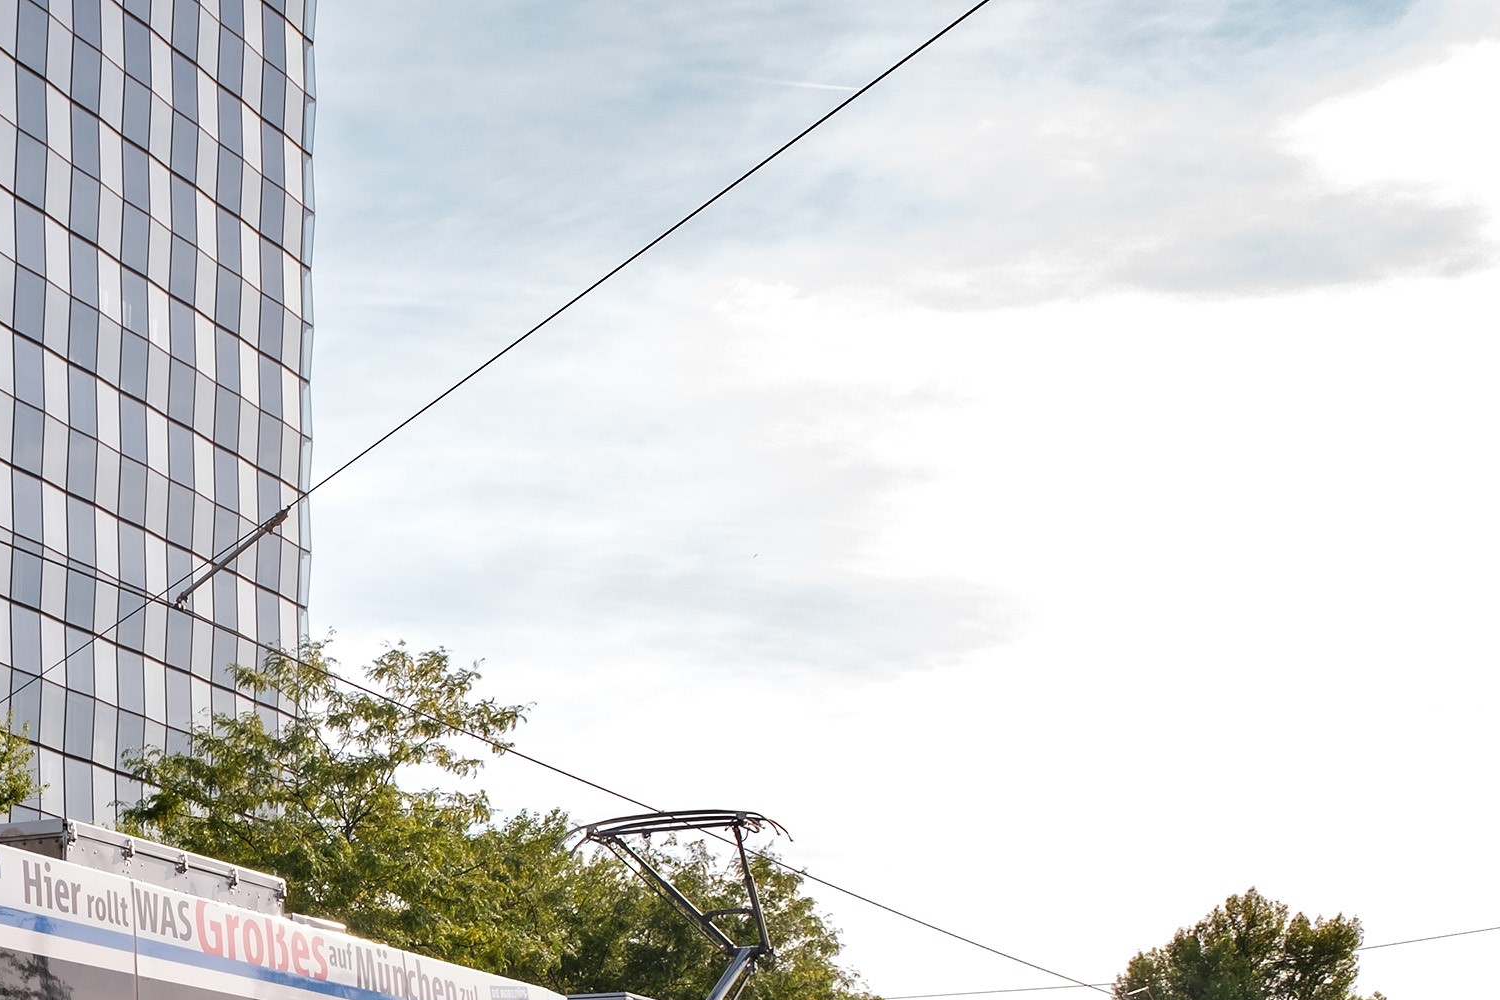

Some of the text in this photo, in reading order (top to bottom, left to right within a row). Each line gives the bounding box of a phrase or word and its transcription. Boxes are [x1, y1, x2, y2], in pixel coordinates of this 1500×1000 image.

[22, 859, 81, 915] Hier
[86, 889, 130, 927] rollt
[133, 887, 193, 942] WAS
[195, 899, 328, 982] Großes
[328, 942, 353, 971] auf
